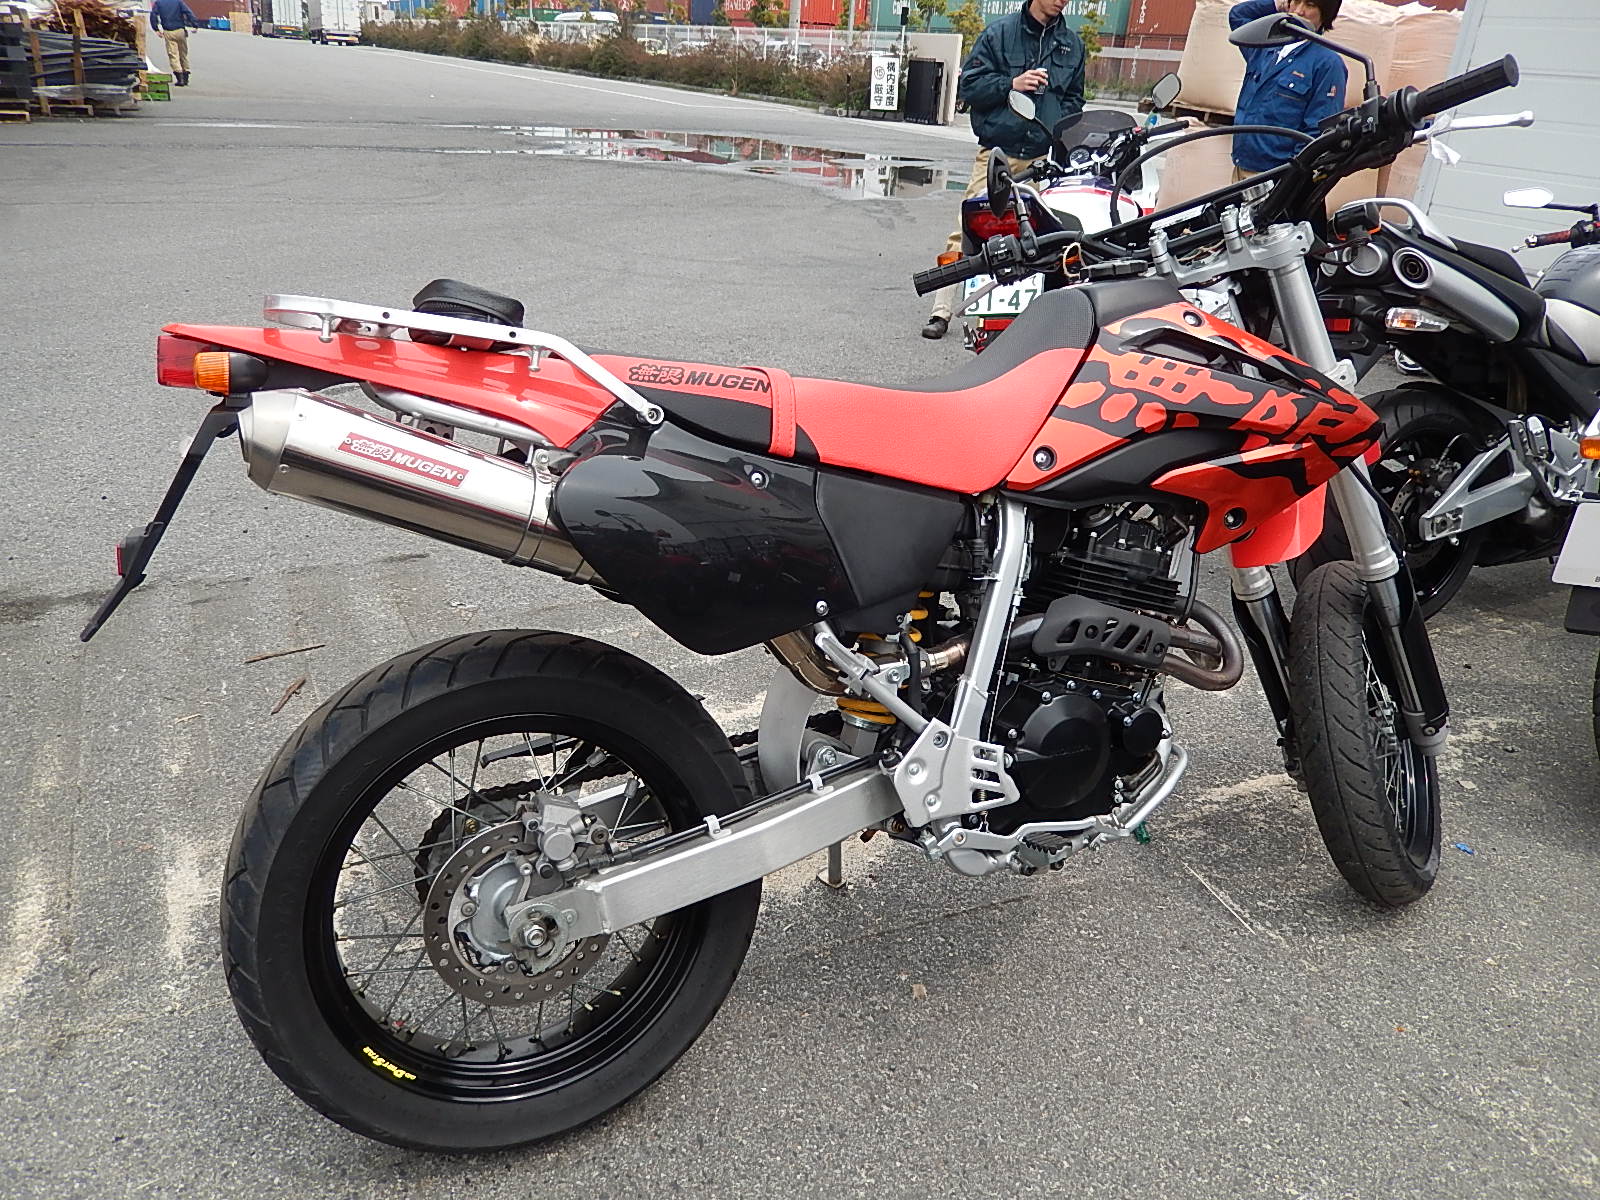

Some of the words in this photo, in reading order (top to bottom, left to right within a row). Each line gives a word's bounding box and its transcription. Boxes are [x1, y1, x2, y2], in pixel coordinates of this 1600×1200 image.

[873, 83, 884, 106] 厳守
[885, 61, 896, 107] 構内速度
[685, 370, 771, 393] MUGEN
[391, 452, 458, 481] MUGEN
